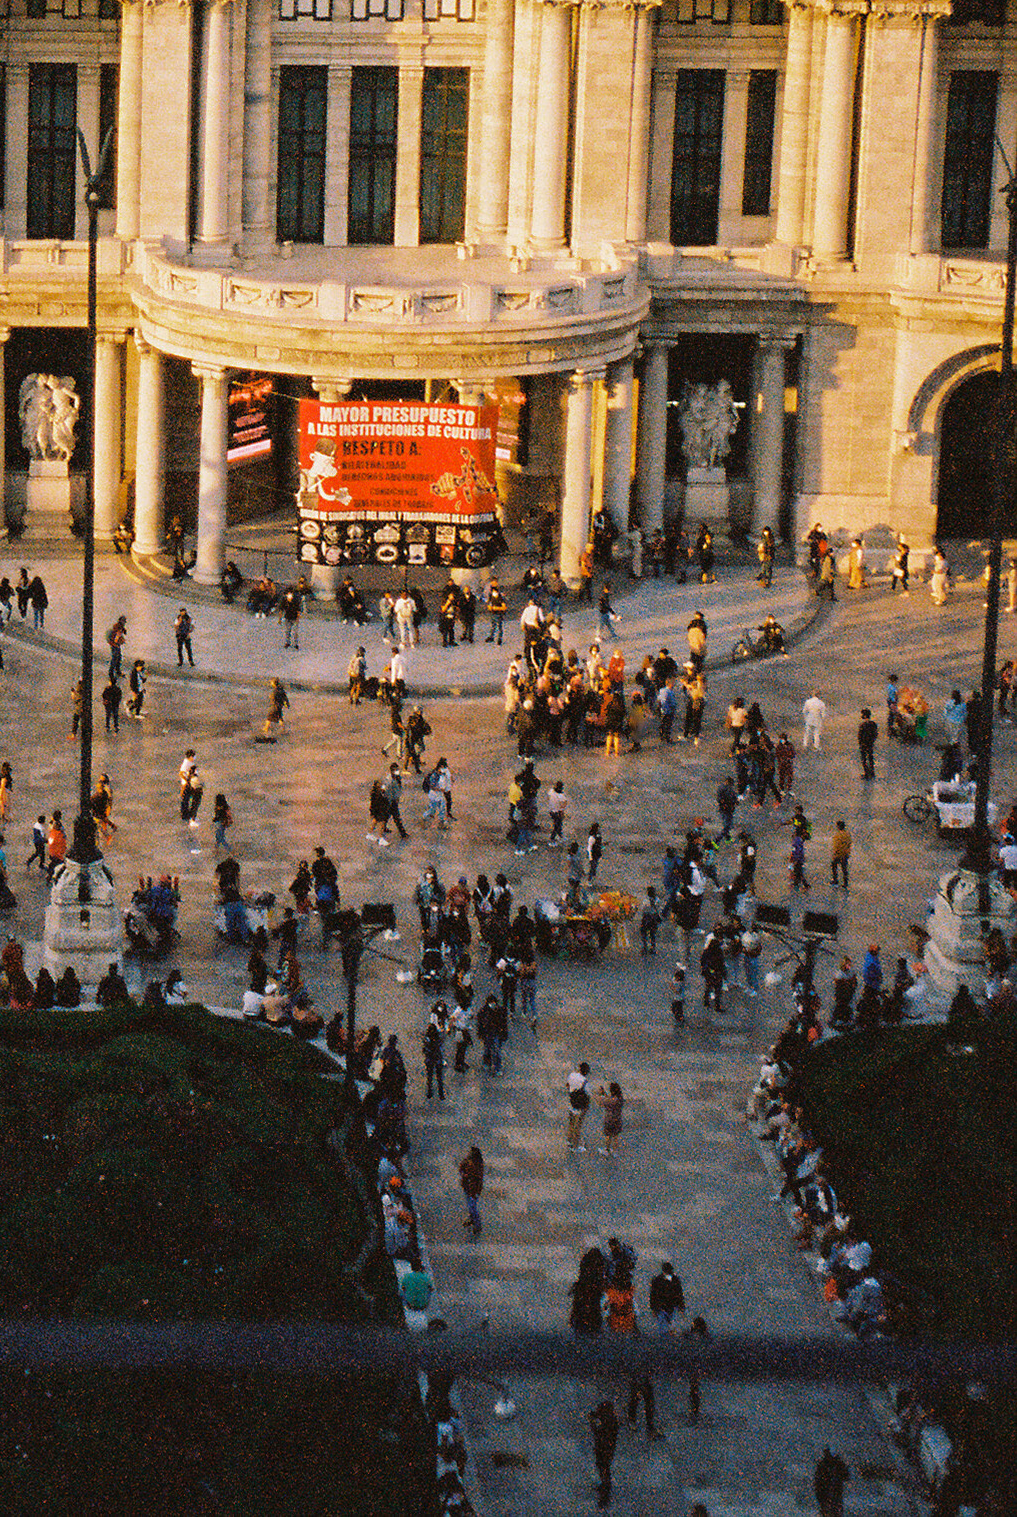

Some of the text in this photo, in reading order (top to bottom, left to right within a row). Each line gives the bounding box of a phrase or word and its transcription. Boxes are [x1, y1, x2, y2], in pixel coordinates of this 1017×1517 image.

[319, 406, 476, 426] MAYOR PRESUPUESTO
[307, 422, 315, 435] A
[317, 422, 337, 436] LAS
[339, 423, 425, 437] INSTITUCIONES
[427, 424, 442, 438] DE
[443, 425, 492, 440] CULTURA
[342, 440, 405, 456] RESPETO
